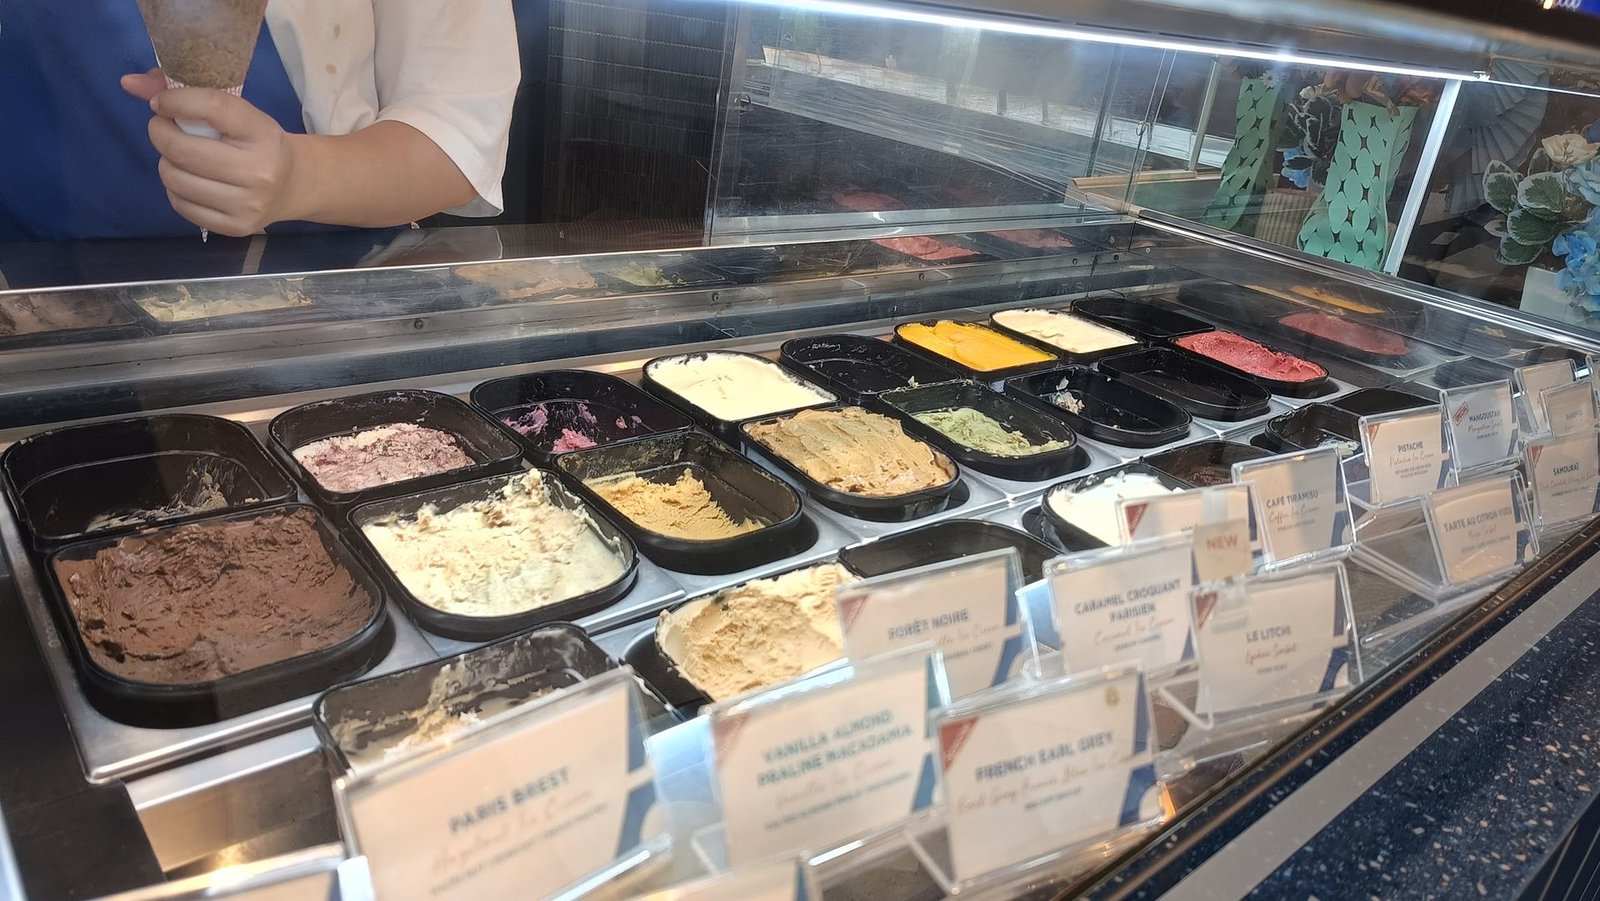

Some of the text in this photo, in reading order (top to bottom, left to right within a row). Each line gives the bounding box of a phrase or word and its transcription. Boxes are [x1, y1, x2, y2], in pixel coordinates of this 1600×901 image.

[1397, 441, 1424, 453] PISTACHE
[1266, 489, 1319, 509] CAFÉ TIRAMISU
[1443, 518, 1466, 532] TARTE
[1466, 515, 1476, 527] AU
[1477, 510, 1498, 523] CITRON
[1205, 533, 1239, 550] NEW
[1074, 578, 1181, 615] CARAMEL CROQUANT
[887, 616, 930, 641] FORÊT
[931, 607, 970, 630] NOIRE
[1109, 601, 1157, 623] PARISIEN
[1246, 625, 1292, 643] LE LITCHI
[763, 730, 829, 765] VANILLA
[832, 708, 894, 741] ALMOND
[756, 753, 823, 788] PRALINE
[826, 723, 914, 764] MACADAMIA
[974, 752, 1036, 784] FRENCH
[1037, 741, 1073, 765] EARL
[1077, 730, 1113, 754] GREY
[449, 765, 569, 836] PARIS BREST
